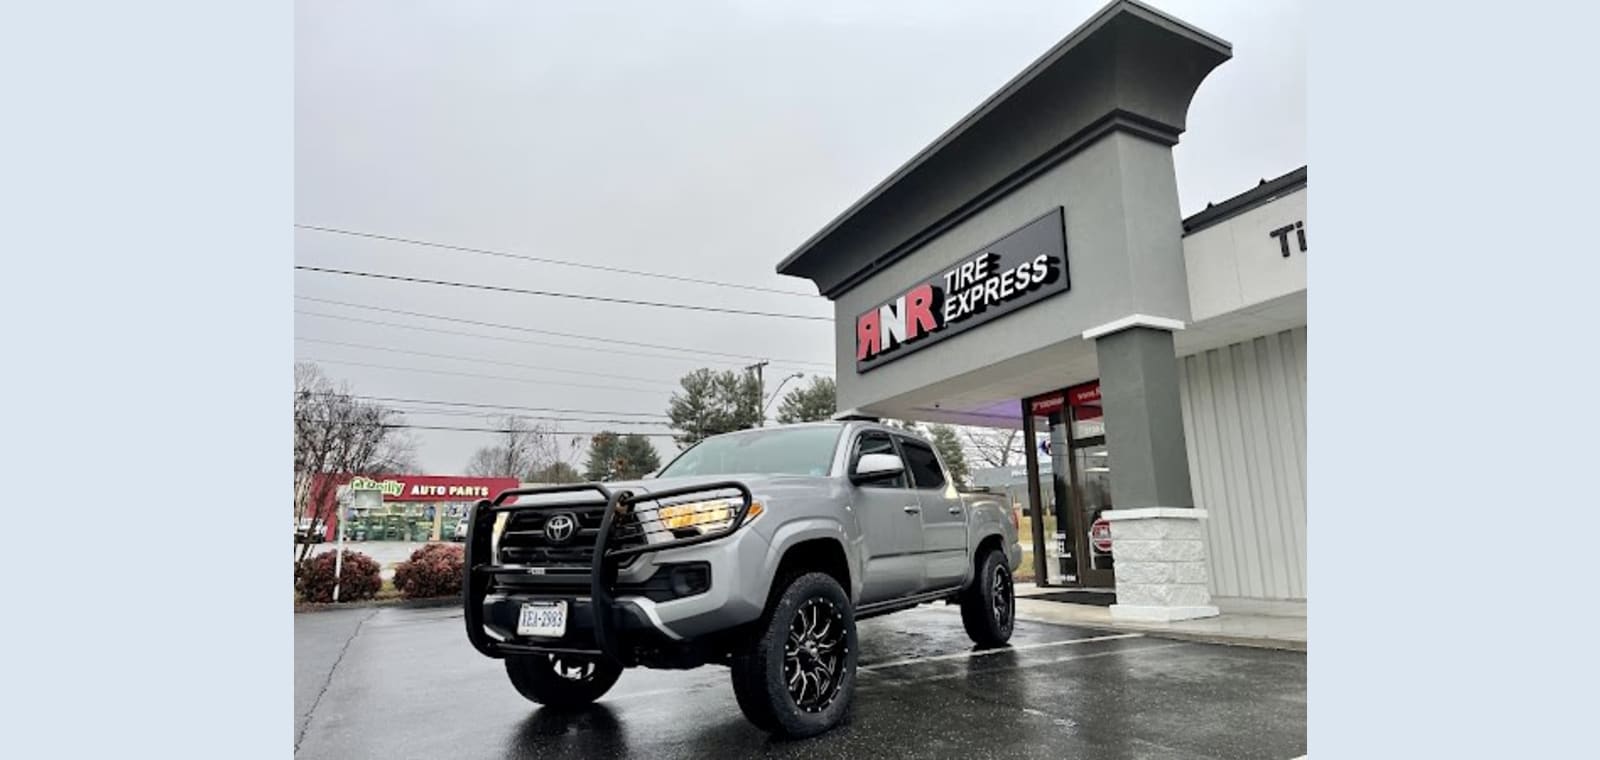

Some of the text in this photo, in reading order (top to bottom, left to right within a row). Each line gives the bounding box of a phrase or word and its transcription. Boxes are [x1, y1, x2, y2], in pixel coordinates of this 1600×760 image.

[943, 253, 989, 294] TIRE
[943, 254, 1048, 323] EXPRESS
[411, 485, 445, 496] AUTO
[449, 485, 489, 497] PARTS
